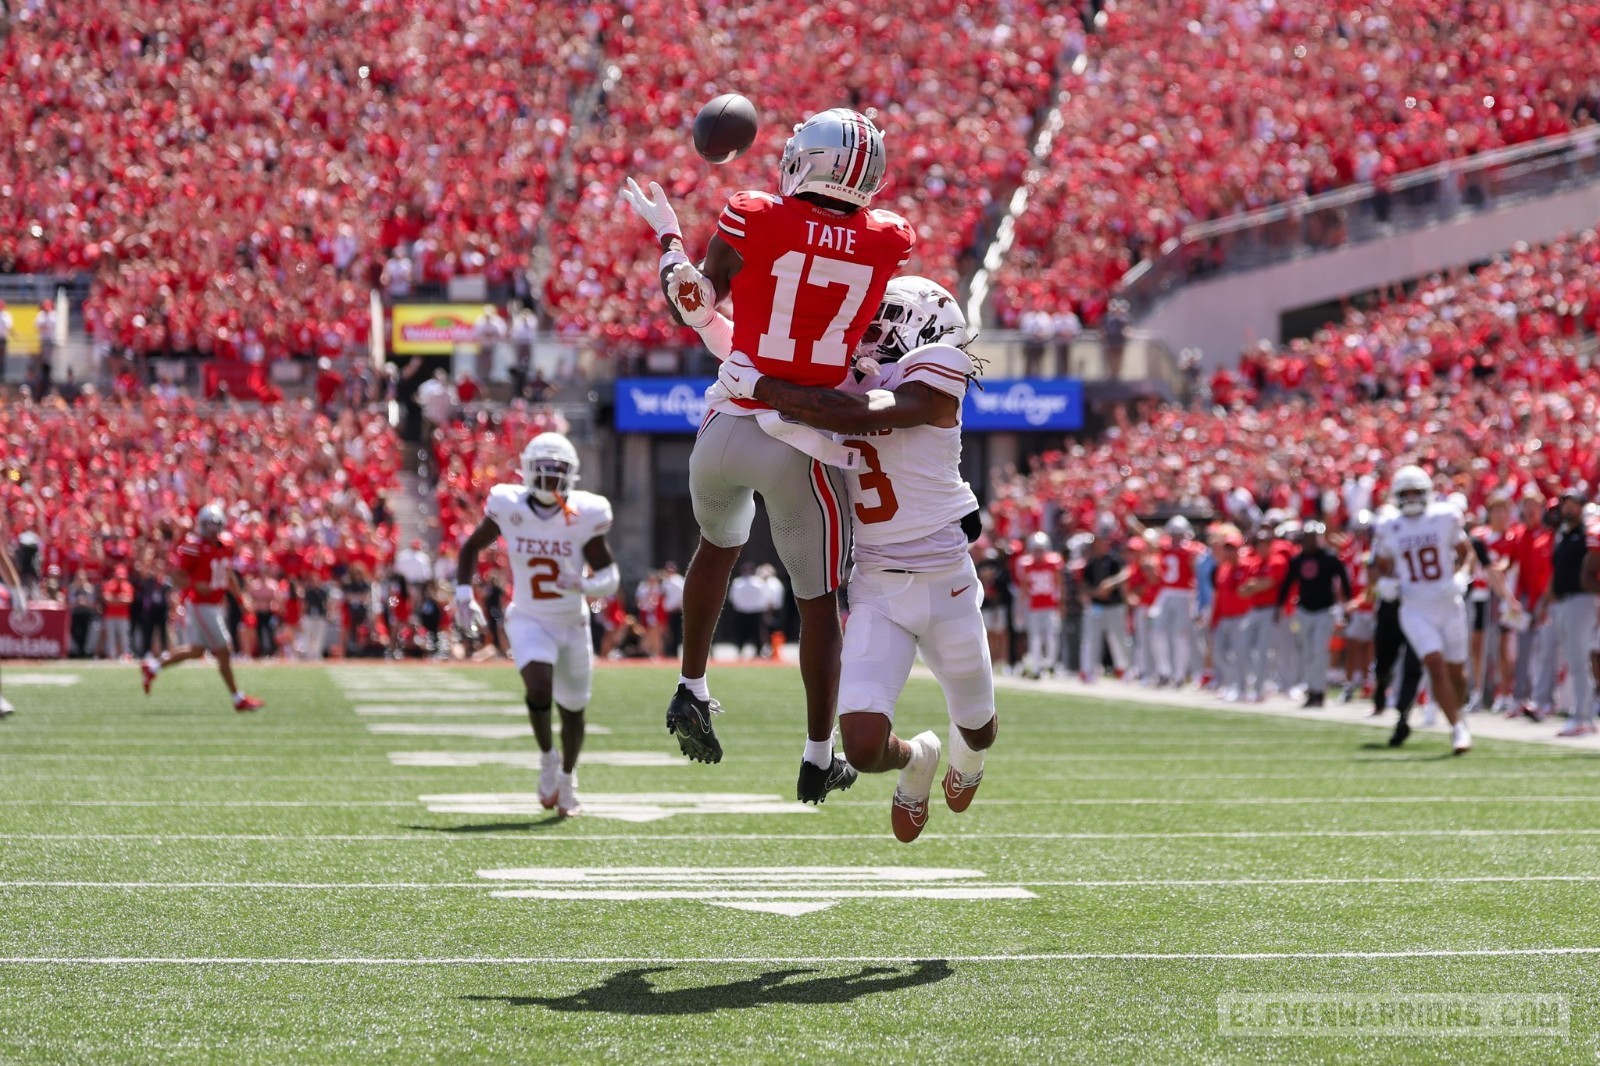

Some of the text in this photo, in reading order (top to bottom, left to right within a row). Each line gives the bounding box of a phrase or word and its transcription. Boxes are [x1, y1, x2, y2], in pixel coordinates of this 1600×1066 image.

[825, 183, 866, 201] BUCKEYES
[805, 220, 857, 255] TATE
[757, 250, 874, 367] 17
[842, 439, 899, 525] 3
[516, 537, 573, 557] TEXAS
[1403, 547, 1442, 583] 18
[527, 556, 564, 600] 2
